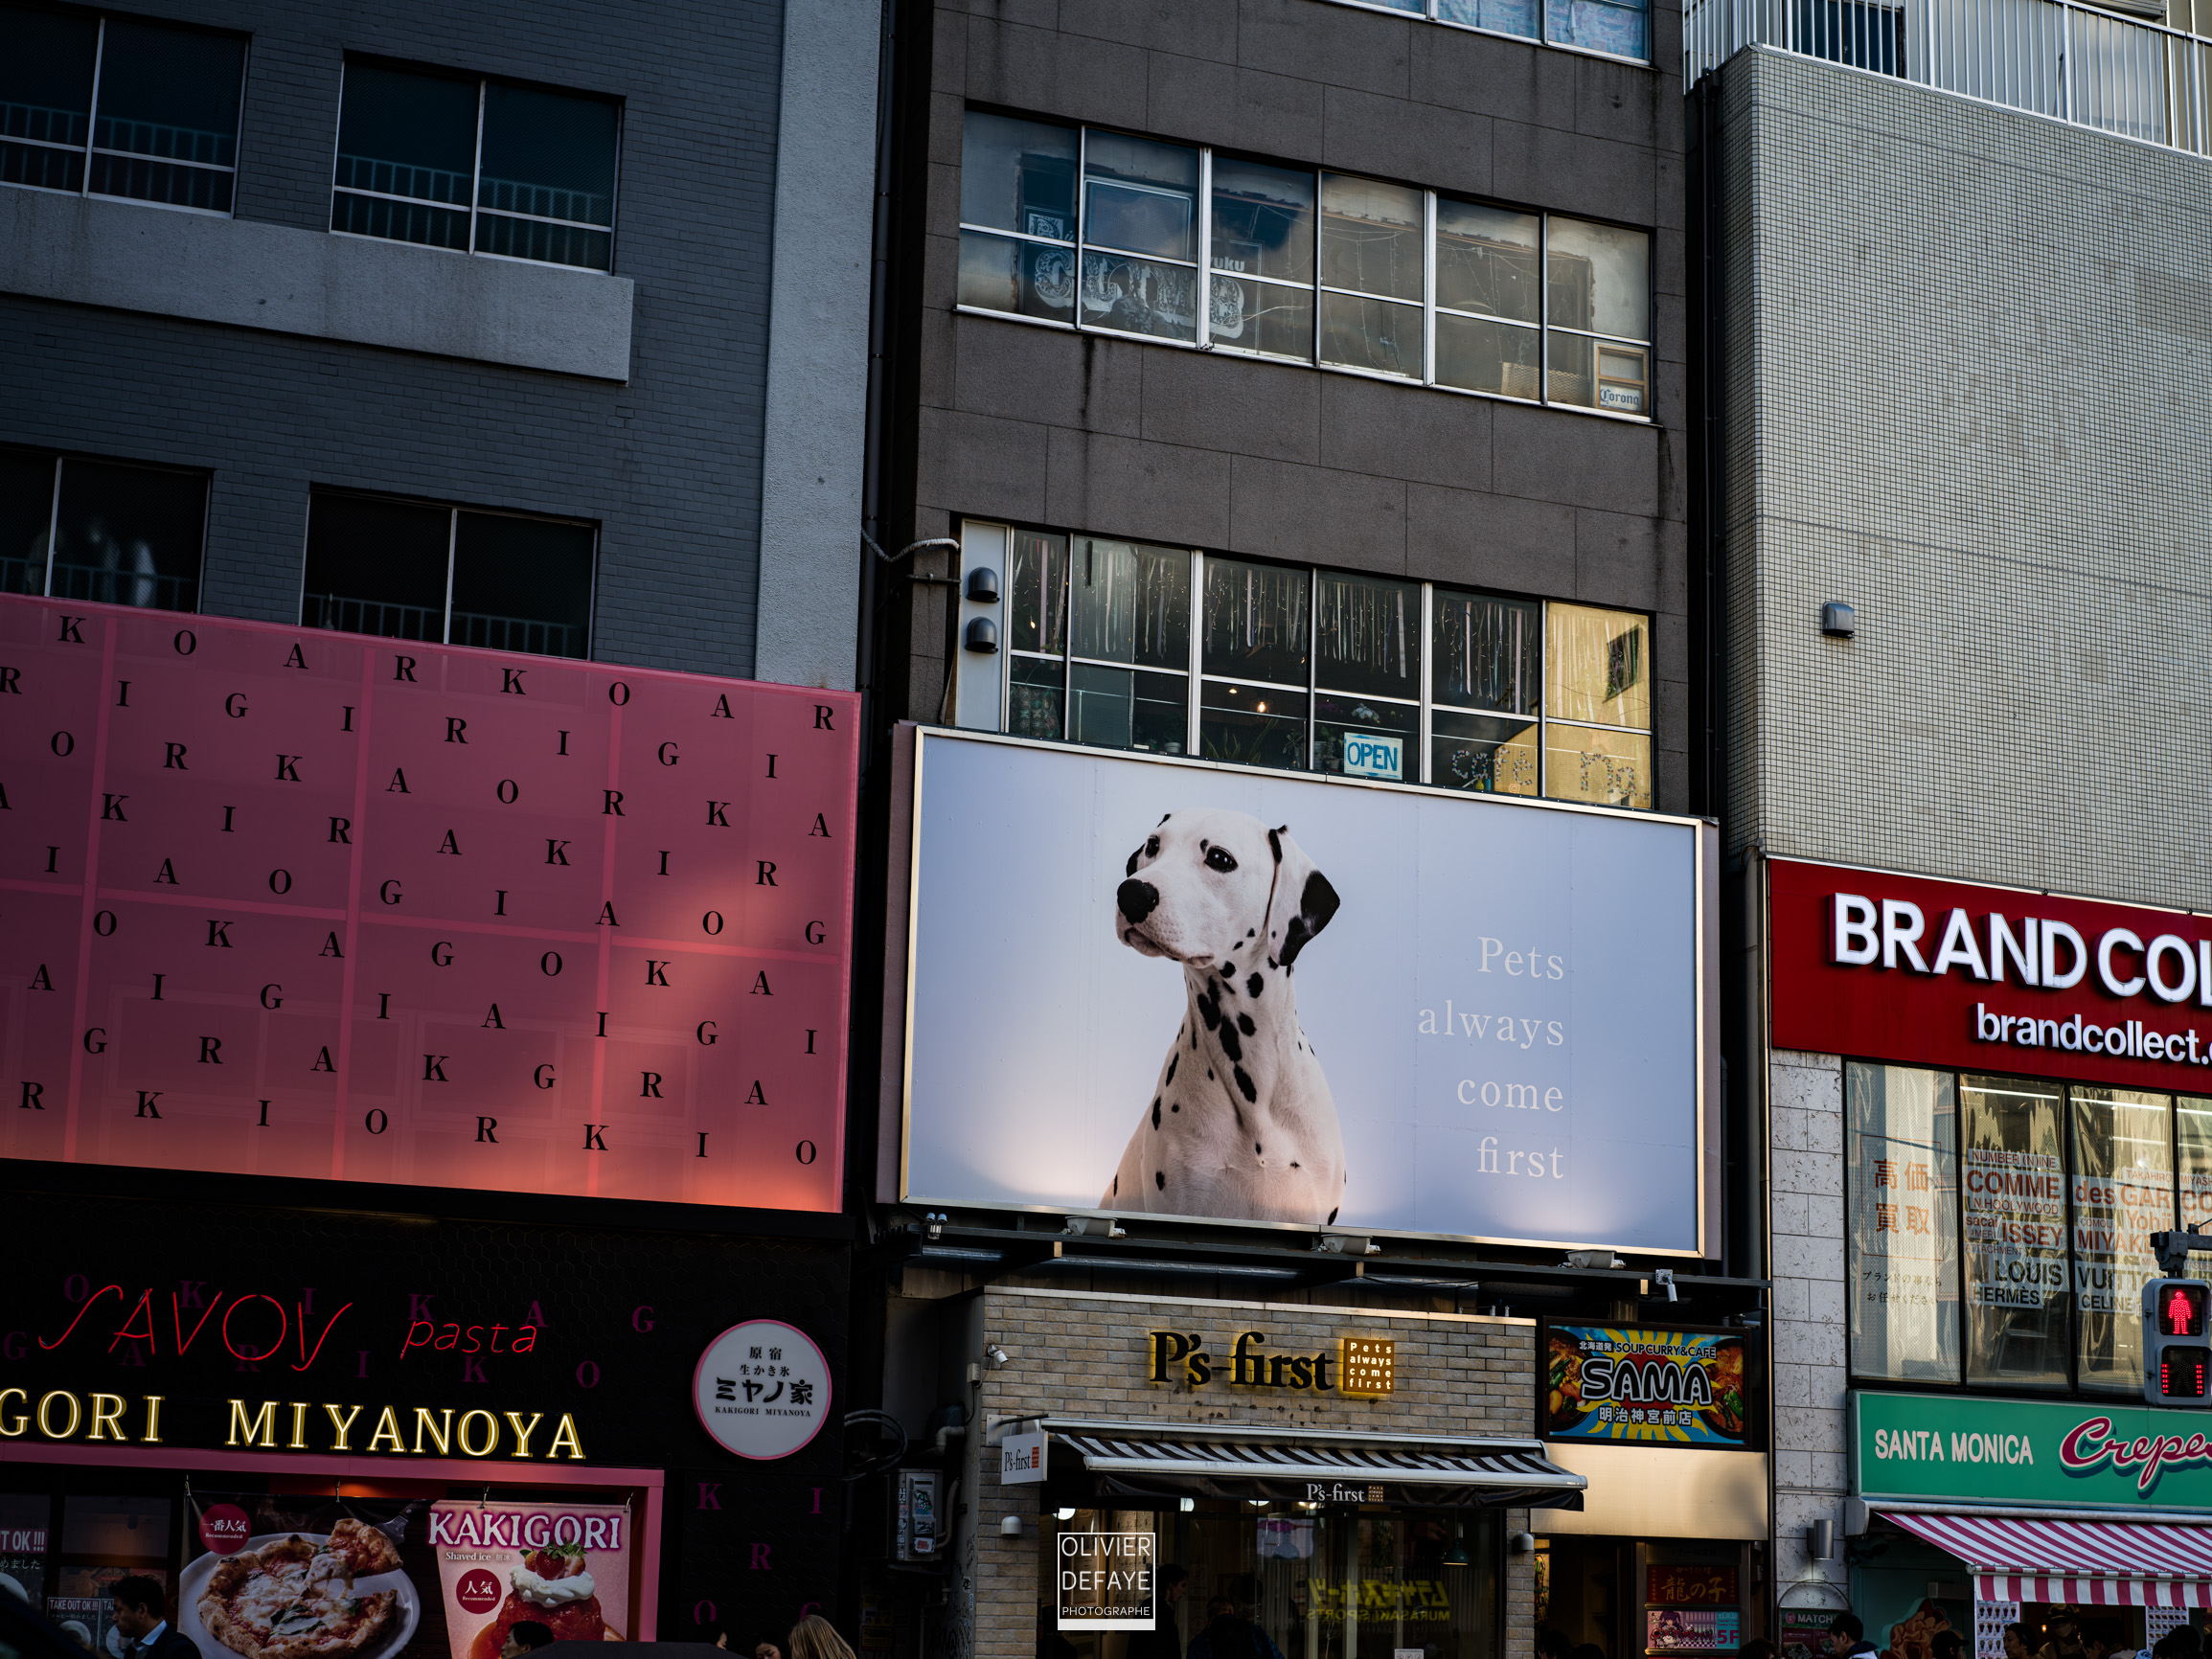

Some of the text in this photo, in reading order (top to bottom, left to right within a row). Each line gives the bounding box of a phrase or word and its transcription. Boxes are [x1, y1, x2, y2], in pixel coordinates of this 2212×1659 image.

[1599, 389, 1640, 406] Corona
[57, 615, 836, 731] K O A R K O A R
[0, 666, 779, 780] R I G I R I G I
[1347, 740, 1398, 771] OPEN
[50, 730, 832, 838] O R K A O R K A
[44, 846, 827, 945] I A O G I A O G
[1834, 892, 2087, 989] BRAND
[1477, 936, 1564, 980] Pets
[27, 963, 818, 1055] A I G I A I G I
[1418, 999, 1564, 1050] always
[1976, 1002, 2212, 1065] brandcollect.
[1457, 1079, 1563, 1112] come
[18, 1080, 817, 1166] R K I O R K I O
[1476, 1136, 1564, 1179] first
[1972, 1150, 2019, 1165] NUMBER
[1874, 1158, 1928, 1193] 高価
[1967, 1170, 2061, 1200] COMME
[2075, 1180, 2115, 1205] des
[2126, 1170, 2172, 1183] TAKAHIRO
[1875, 1203, 1930, 1236] 買取
[1973, 1197, 2059, 1215] N.HOOLYWOOD
[1966, 1216, 1998, 1228] sacai
[2002, 1221, 2064, 1247] ISSEY
[1965, 1243, 2023, 1257] ATTACHMENT
[1995, 1260, 2165, 1292] LOUIS VUITTO
[1973, 1286, 2041, 1306] HERMÈS
[2081, 1294, 2133, 1311] CELINE
[399, 1320, 538, 1359] pasta
[748, 1346, 783, 1360] 原宿
[1350, 1342, 1392, 1354] Pets
[740, 1364, 790, 1377] 生かき氷
[1349, 1354, 1392, 1368] always
[1349, 1368, 1392, 1378] come
[716, 1376, 813, 1405] ミヤノ家
[1349, 1378, 1392, 1390] first
[1581, 1357, 1713, 1405] SAMA
[0, 1387, 586, 1460] GORI MIYANOYA
[715, 1406, 811, 1417] KAKIGORI MIYANOYA
[1598, 1406, 1693, 1425] 明治神宮前店
[1875, 1429, 1945, 1462] SANTA
[1951, 1431, 2034, 1466] MONICA
[696, 1482, 723, 1511] K
[201, 1519, 247, 1533] 一番人気
[427, 1511, 621, 1549] KAKIGORI
[445, 1551, 477, 1561] Shaved
[478, 1552, 491, 1562] ice
[748, 1542, 774, 1571] R
[464, 1579, 493, 1596] 人気
[1660, 1574, 1727, 1603] 龍の子
[49, 1600, 67, 1610] TAKE
[67, 1600, 81, 1611] OUT
[81, 1601, 92, 1611] OK
[1717, 1629, 1740, 1645] 5F
